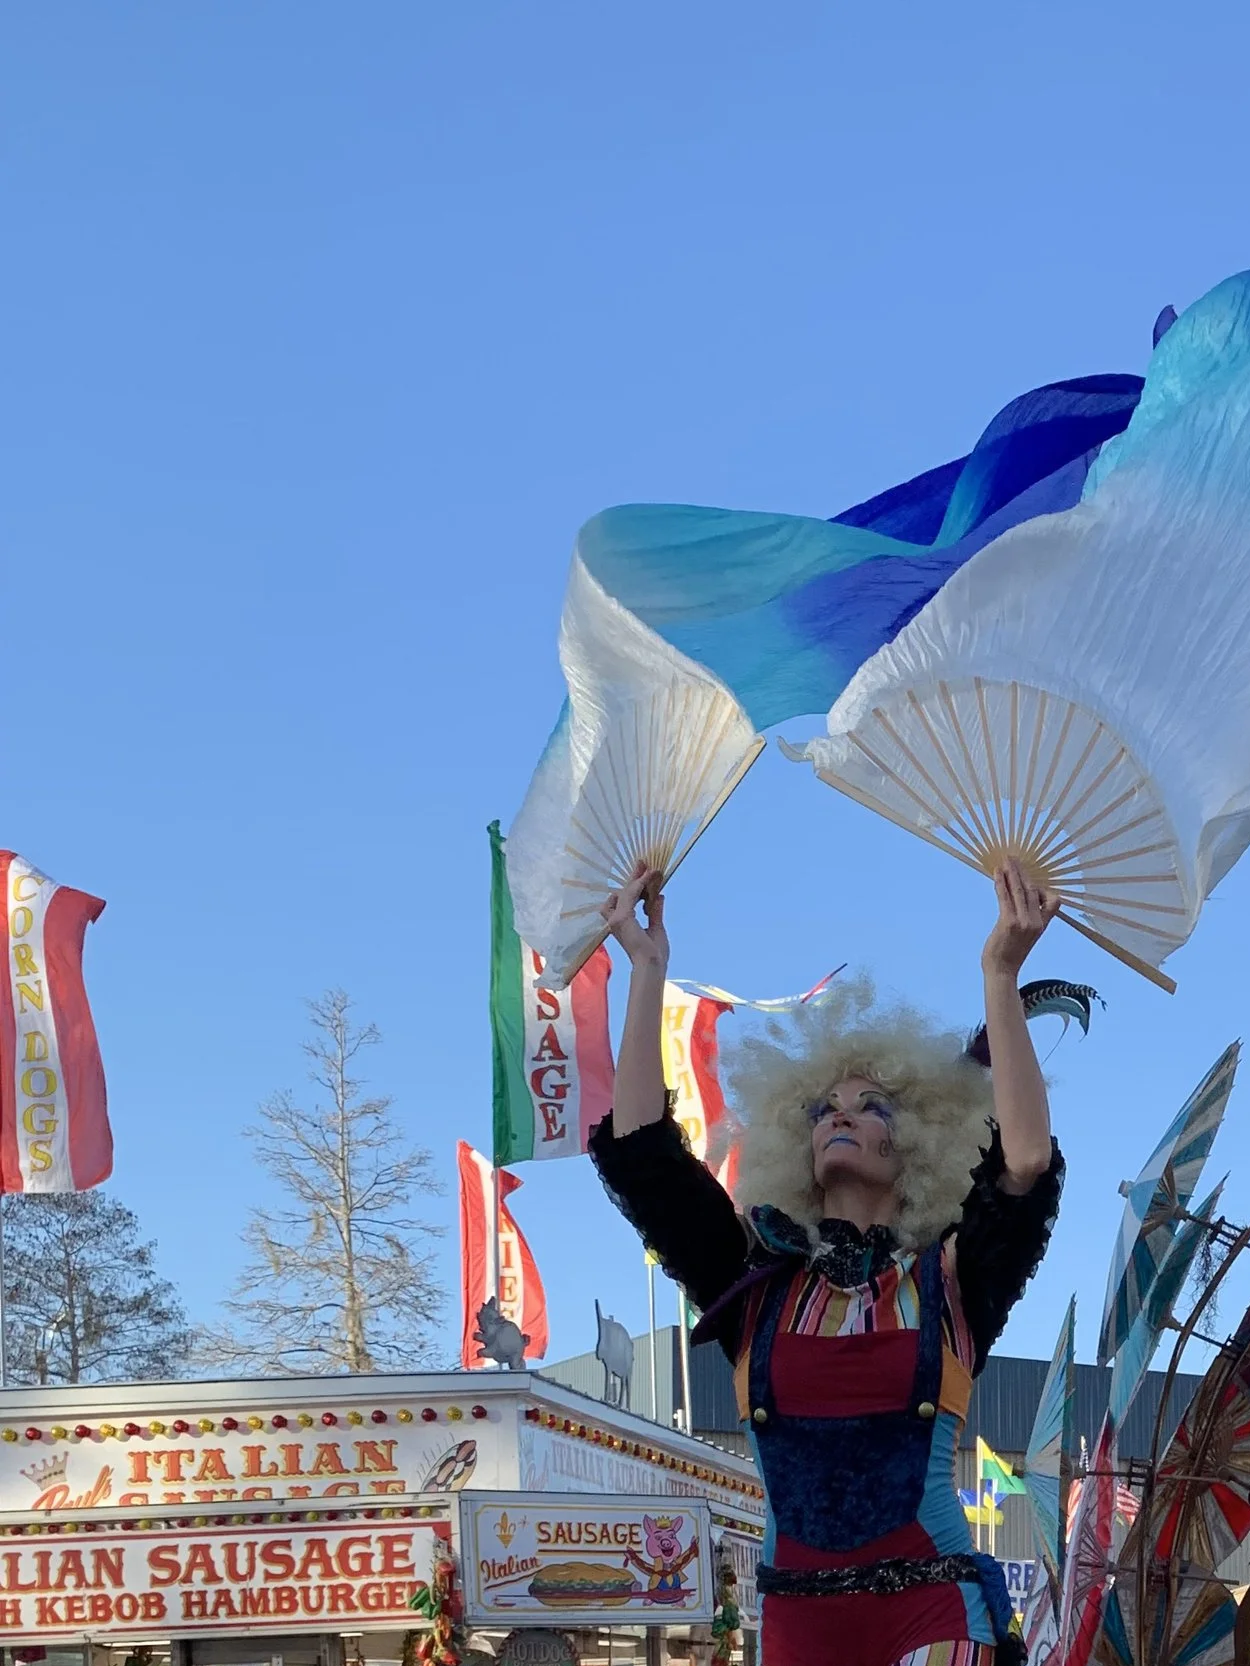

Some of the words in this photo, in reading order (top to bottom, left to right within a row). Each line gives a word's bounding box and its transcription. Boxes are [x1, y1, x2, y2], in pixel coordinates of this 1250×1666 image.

[9, 874, 45, 1014] CORN
[21, 1031, 59, 1173] DOGS
[127, 1439, 399, 1485] ITALIAN
[537, 1521, 643, 1545] SAUSAGE
[0, 1547, 126, 1594] LIAN
[147, 1533, 415, 1584] SAUSAGE
[480, 1556, 541, 1583] Italian
[35, 1591, 169, 1627] KEBOB
[507, 1641, 537, 1662] HOT
[540, 1642, 572, 1663] DOG
